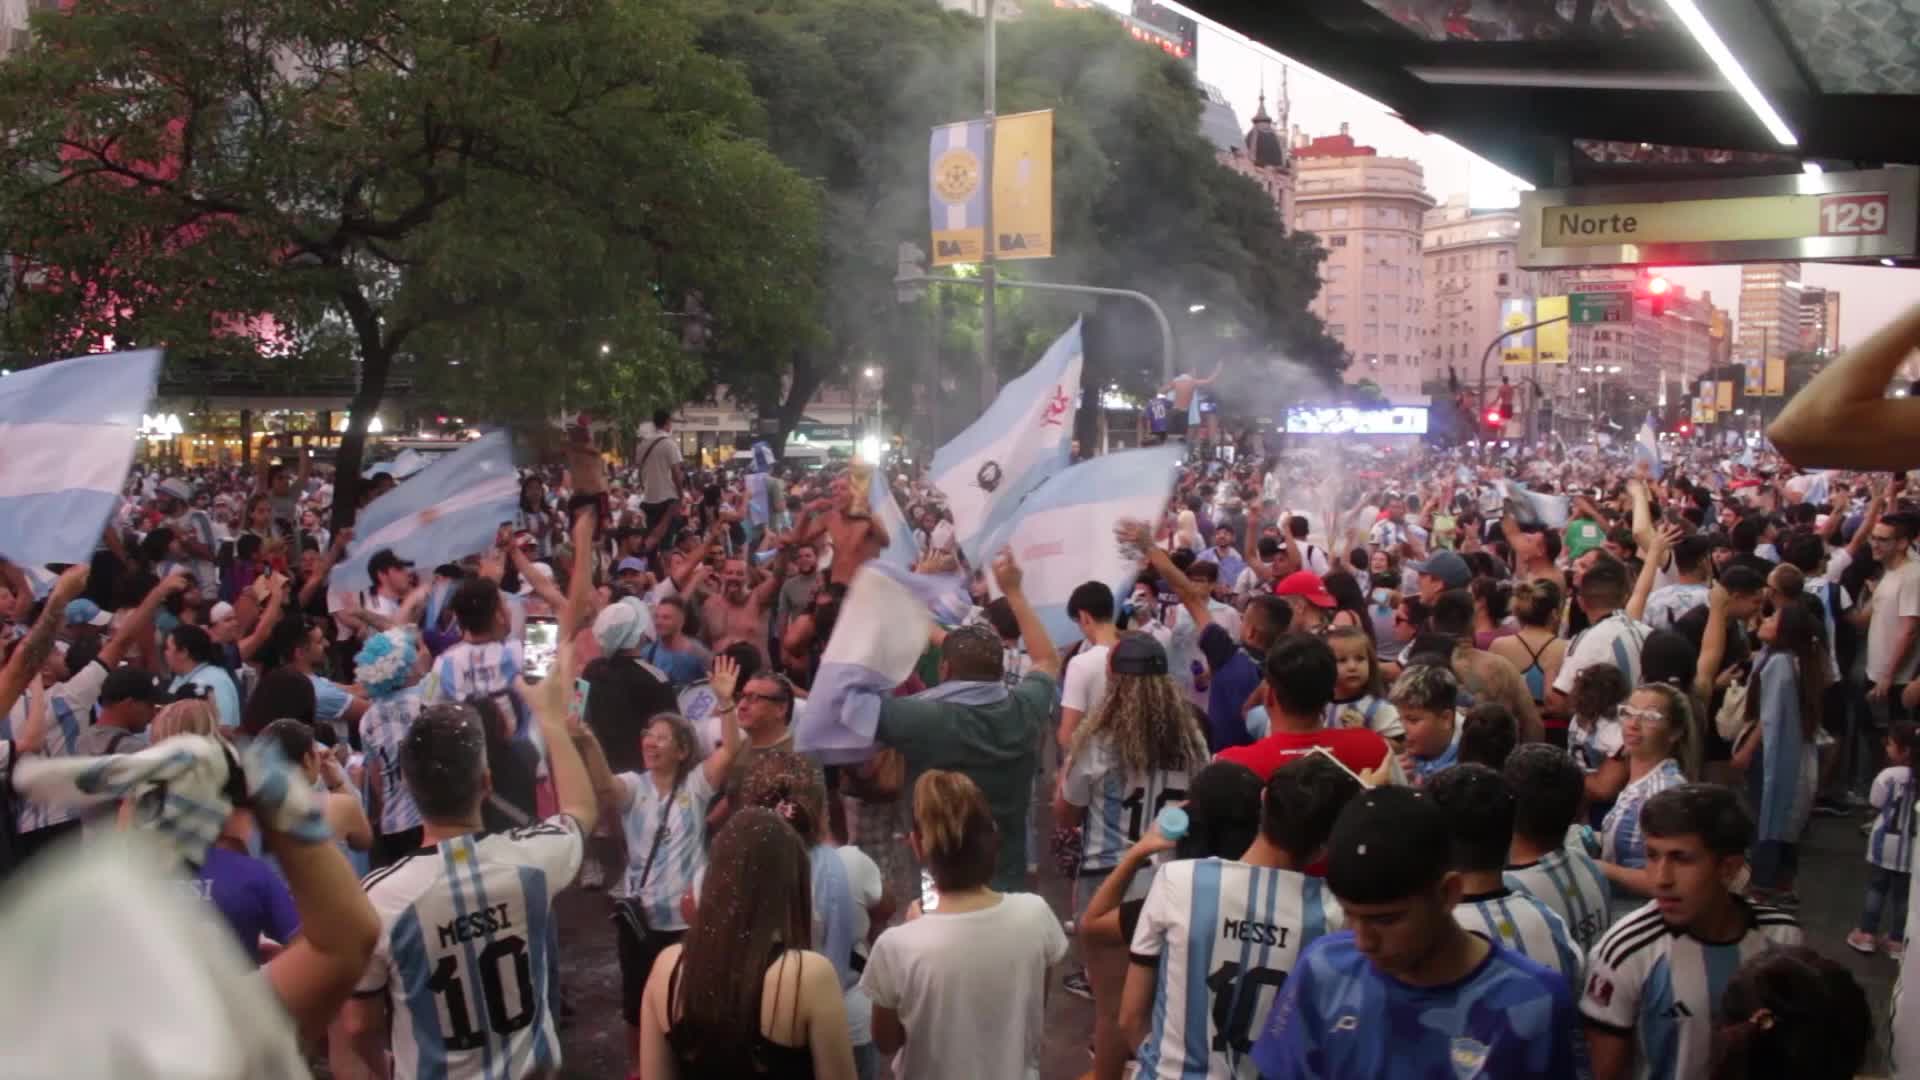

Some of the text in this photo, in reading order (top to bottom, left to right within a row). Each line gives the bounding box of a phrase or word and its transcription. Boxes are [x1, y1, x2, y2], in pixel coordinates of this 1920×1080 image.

[1558, 200, 1887, 236] Norte 129
[437, 903, 512, 949] MESSI
[1223, 917, 1290, 949] MESSI
[425, 935, 537, 1051] 10
